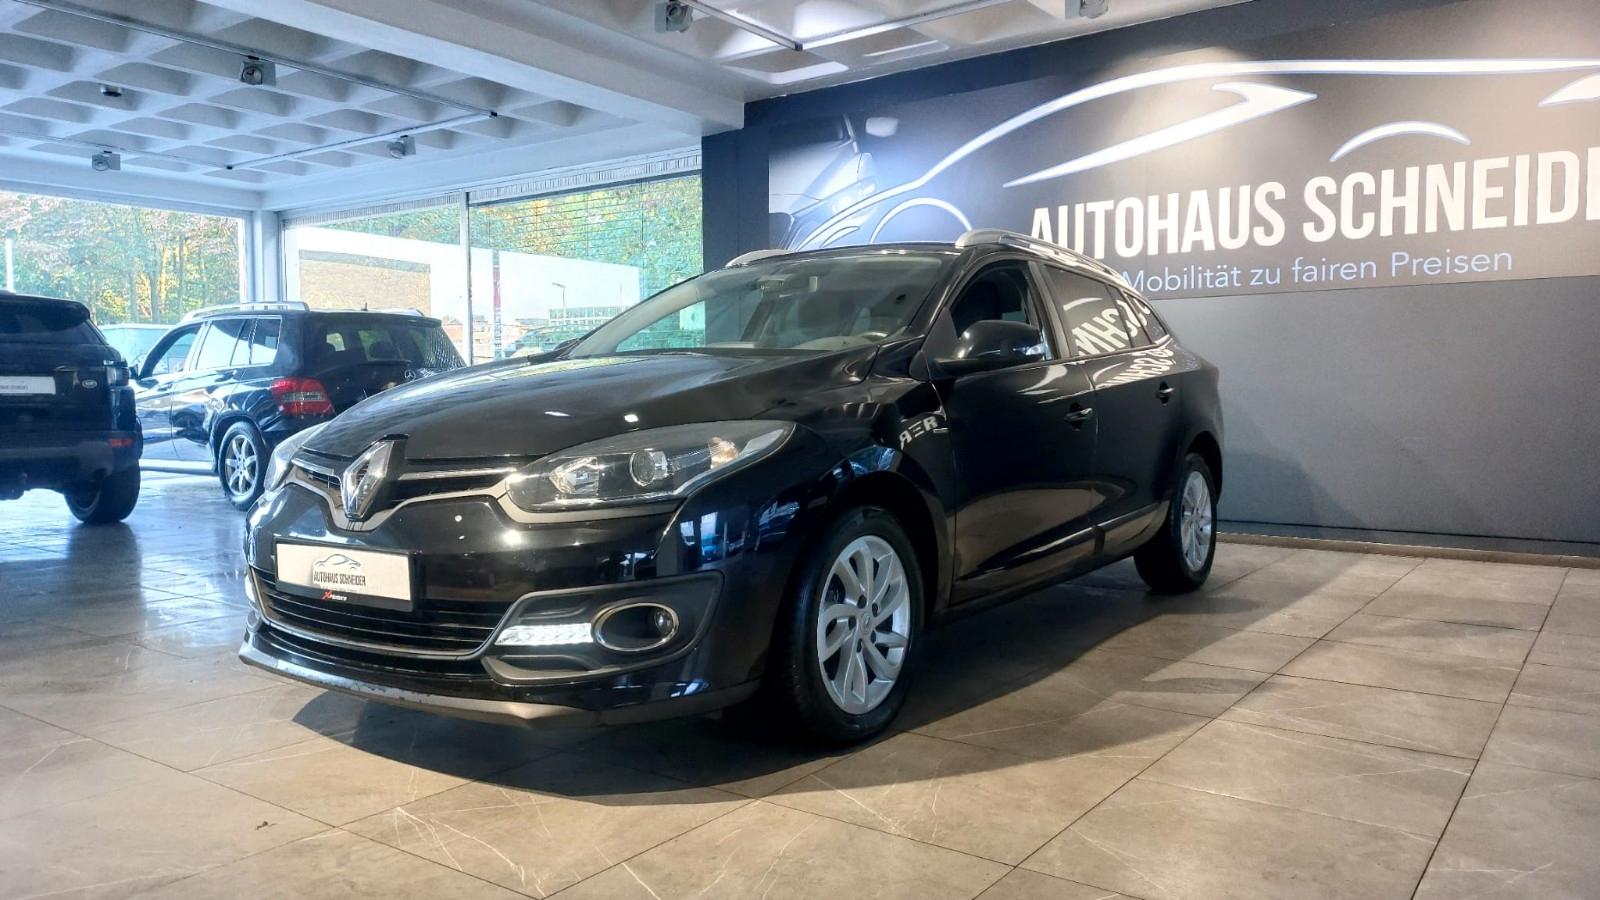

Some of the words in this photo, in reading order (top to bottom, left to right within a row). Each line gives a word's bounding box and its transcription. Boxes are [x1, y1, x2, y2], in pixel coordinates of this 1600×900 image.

[1030, 181, 1286, 260] AUTOHAUS
[1121, 263, 1241, 293] Mobilität
[1250, 267, 1281, 286] zu
[1292, 256, 1378, 283] fairen
[1391, 248, 1513, 277] Preisen
